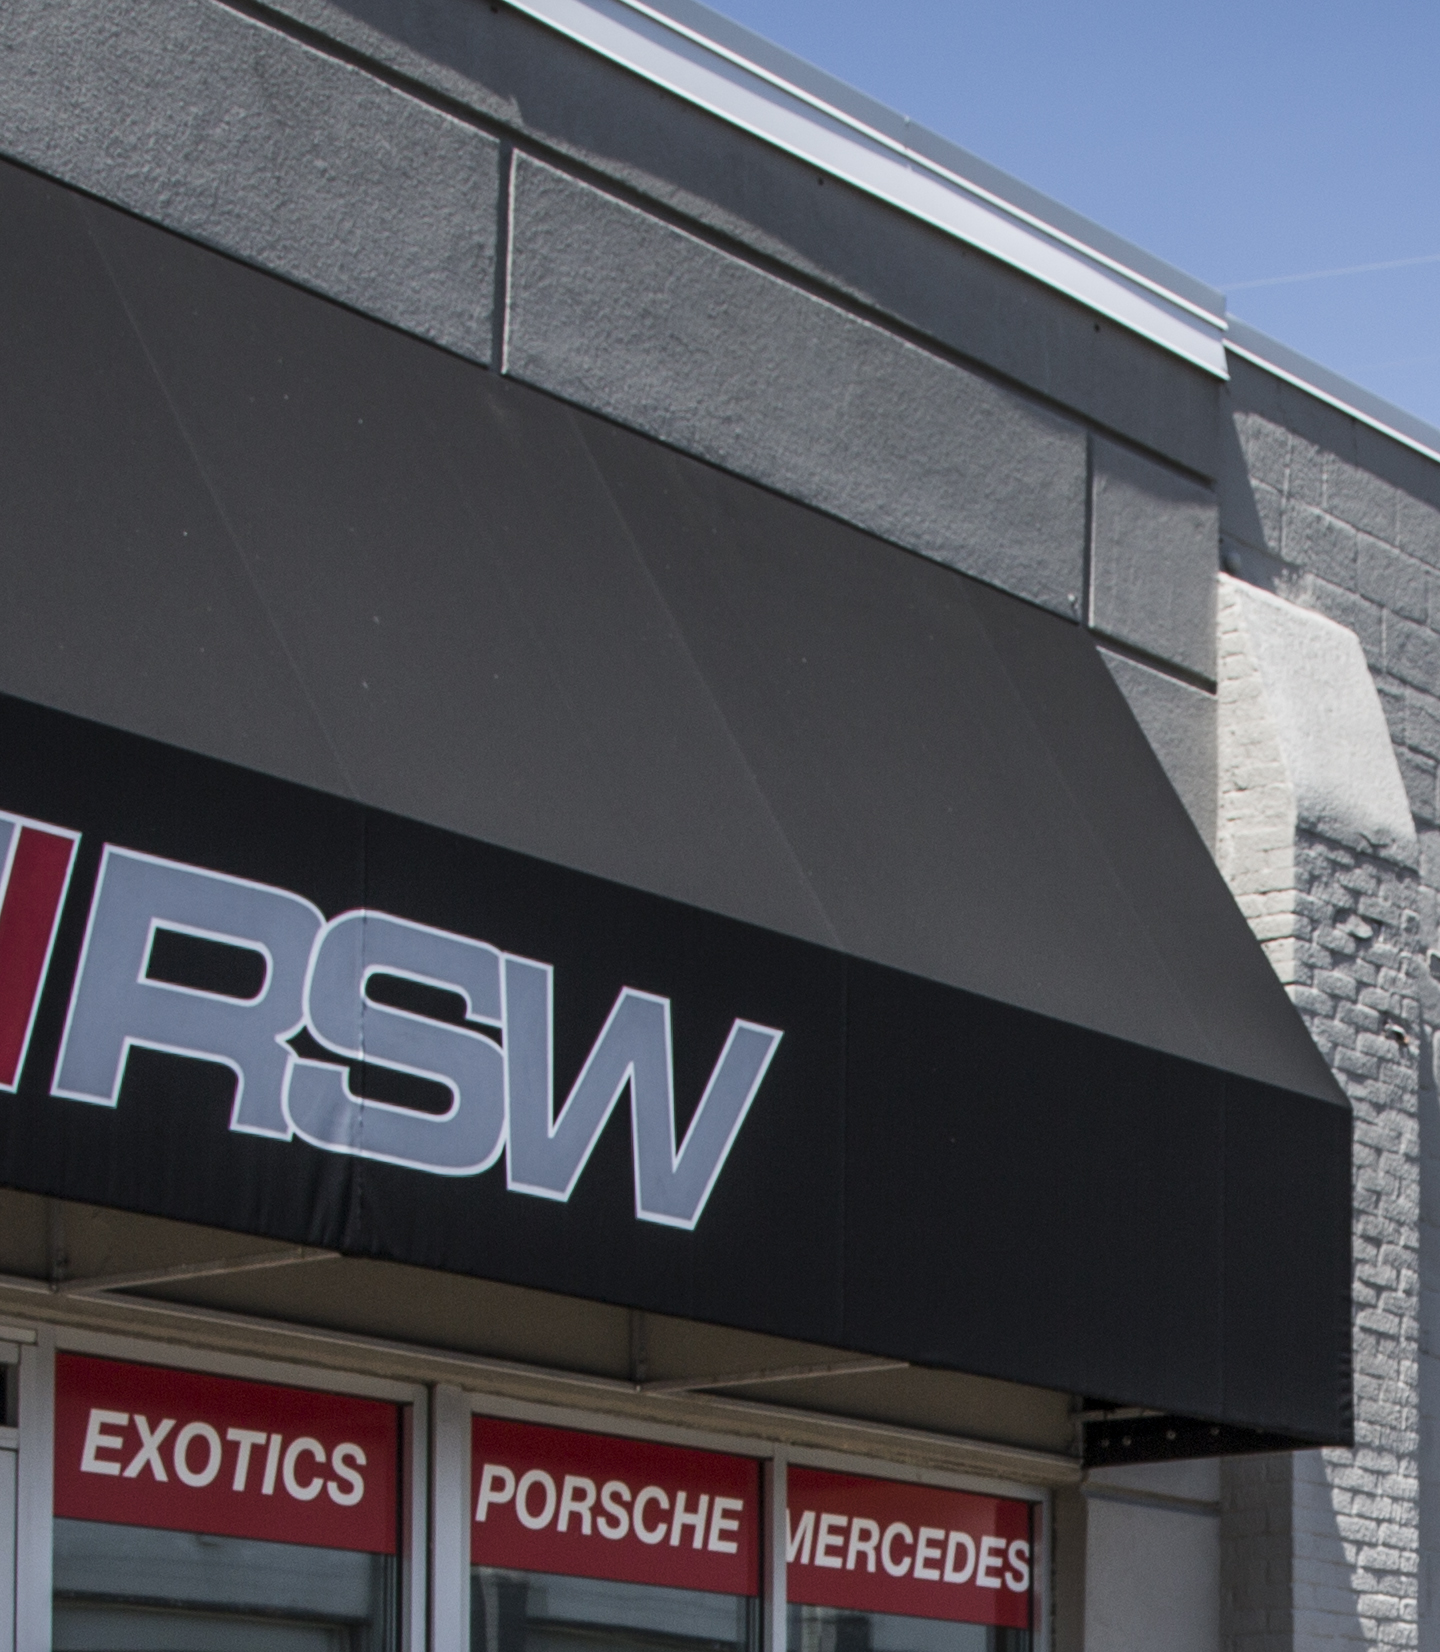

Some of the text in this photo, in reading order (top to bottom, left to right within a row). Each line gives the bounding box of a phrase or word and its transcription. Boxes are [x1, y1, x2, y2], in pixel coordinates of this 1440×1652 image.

[51, 842, 784, 1230] RSW
[79, 1408, 367, 1508] EXOTICS
[475, 1462, 745, 1555] PORSCHE
[786, 1508, 1030, 1593] MERCEDES
